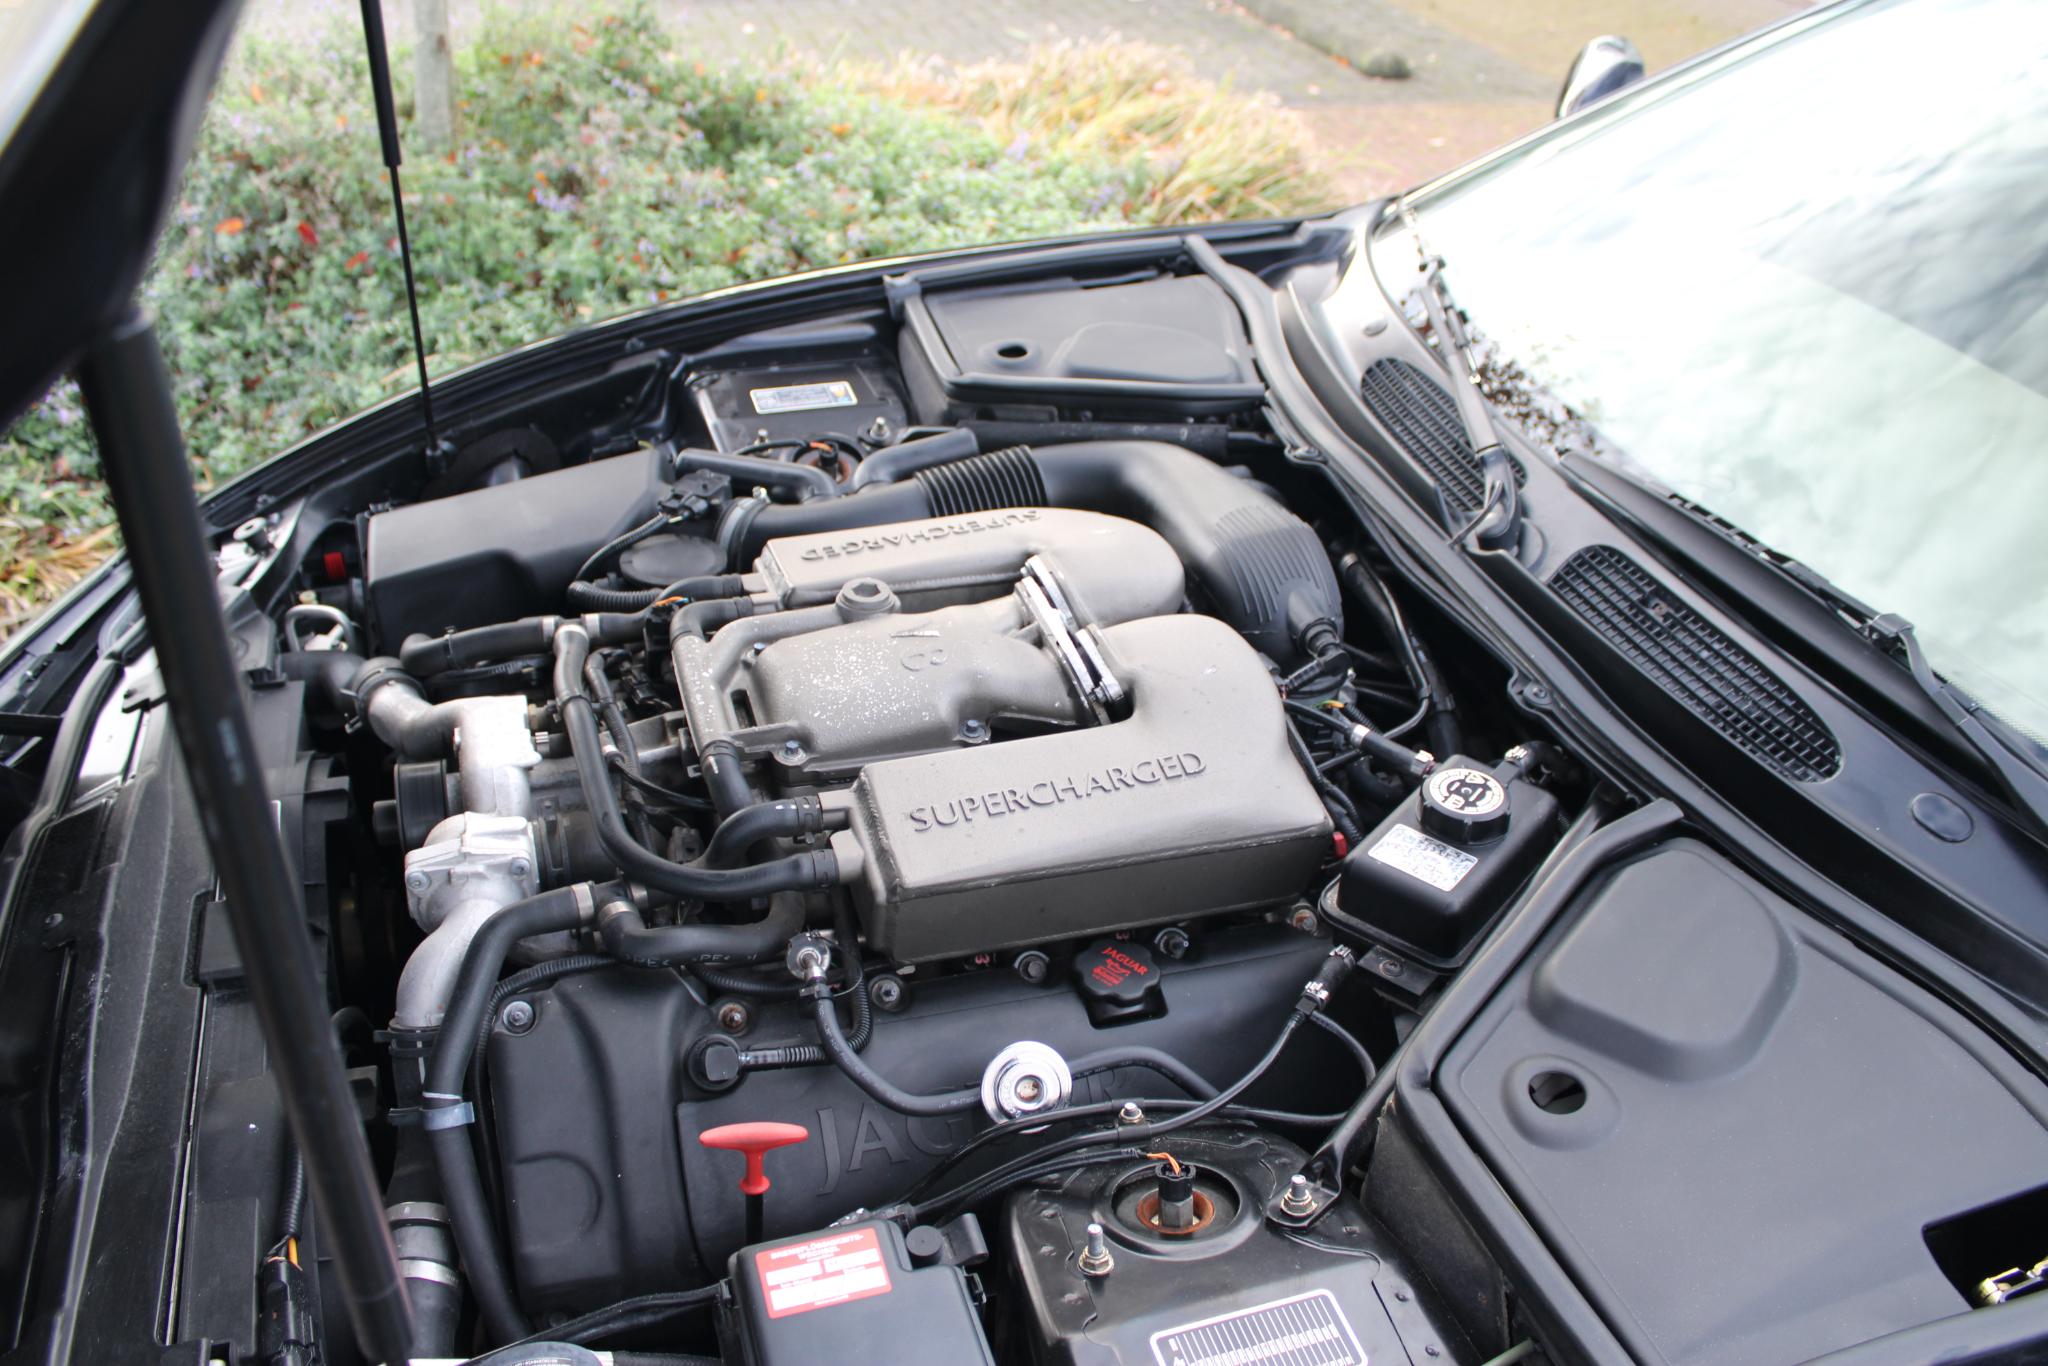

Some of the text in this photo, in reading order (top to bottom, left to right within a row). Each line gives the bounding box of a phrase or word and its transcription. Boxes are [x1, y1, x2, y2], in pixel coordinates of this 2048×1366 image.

[799, 509, 1042, 561] SUPERCHARGED
[908, 752, 1207, 832] SUPERCHARGED
[1102, 947, 1149, 975] JAGUAR
